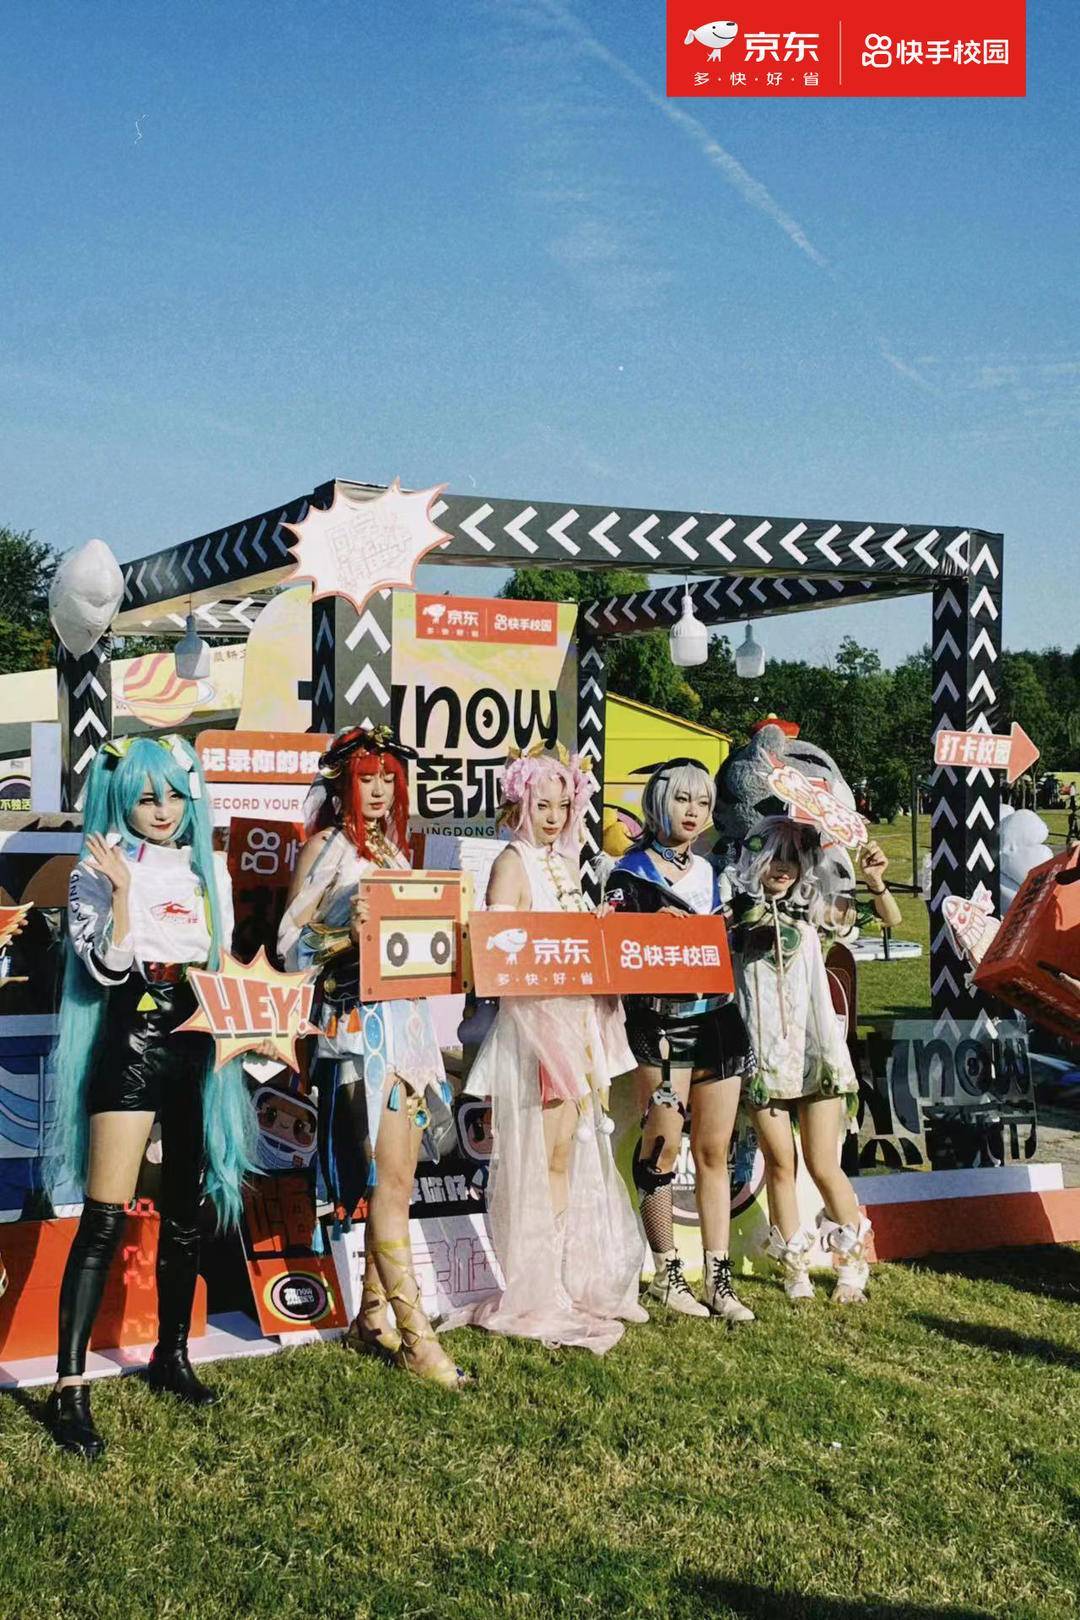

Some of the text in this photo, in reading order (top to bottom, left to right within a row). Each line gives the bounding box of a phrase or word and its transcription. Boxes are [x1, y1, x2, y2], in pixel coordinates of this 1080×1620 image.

[447, 609, 479, 626] 京东
[210, 797, 299, 810] ECORD YOUR
[532, 938, 592, 965] 京东
[644, 945, 721, 967] 快手校园
[193, 973, 315, 1033] HEY!
